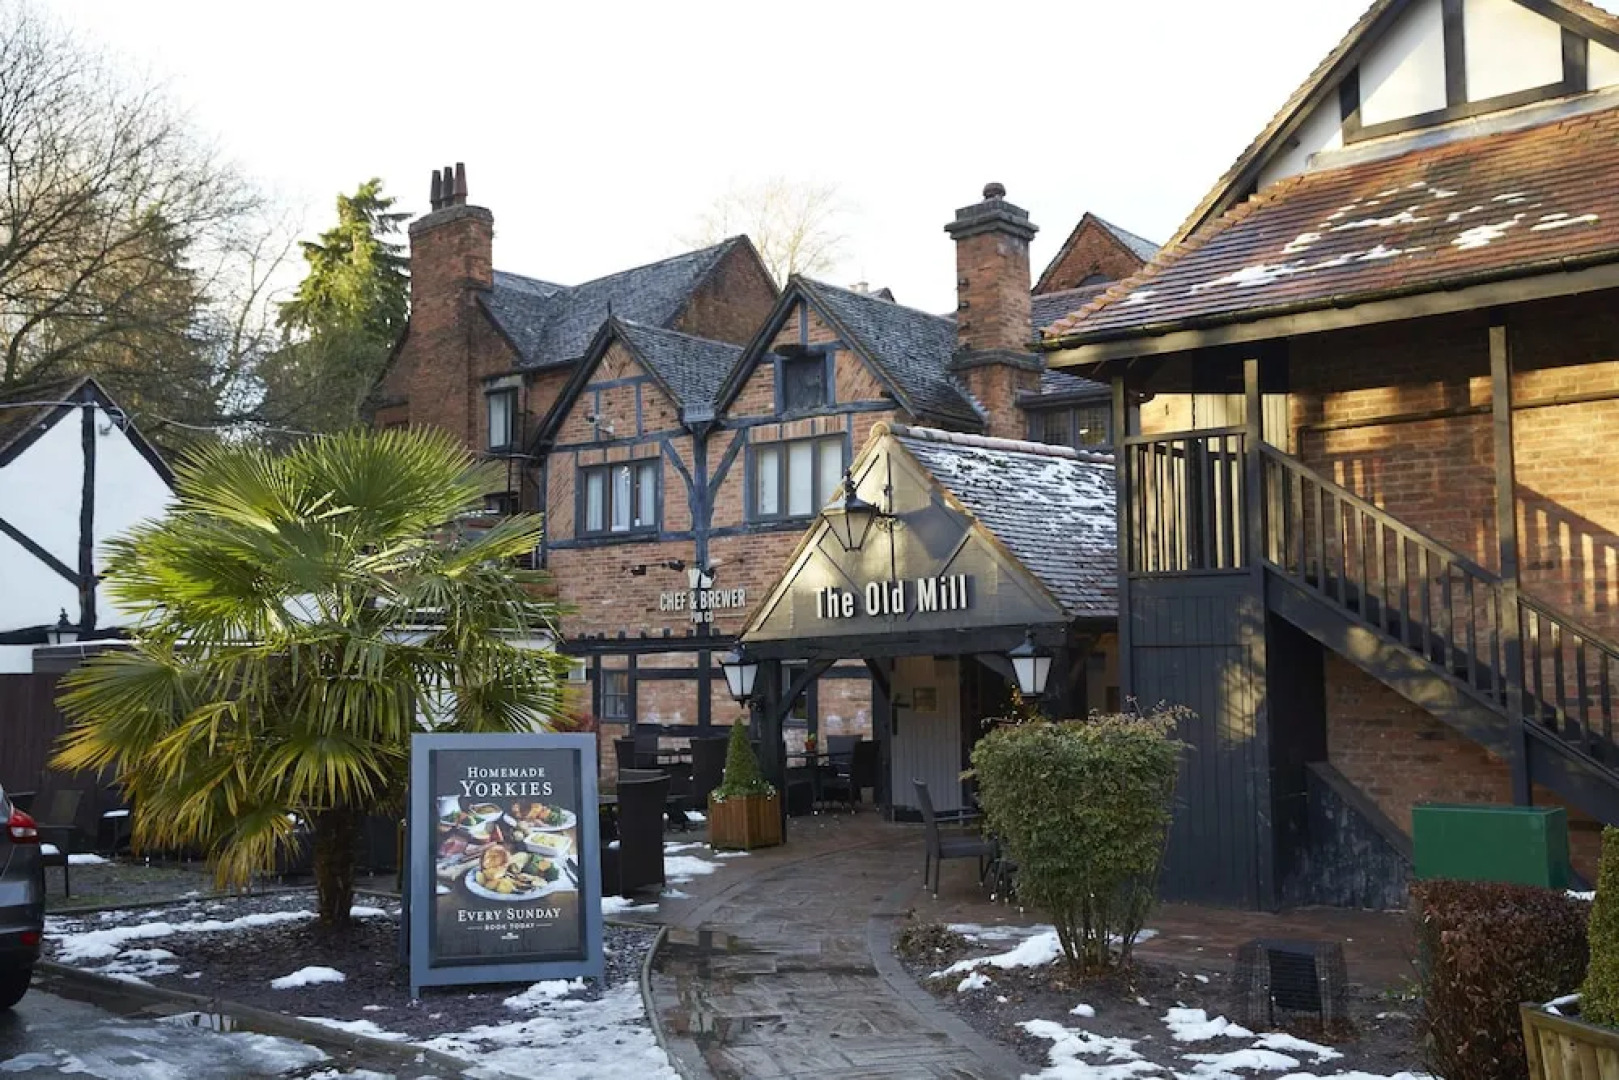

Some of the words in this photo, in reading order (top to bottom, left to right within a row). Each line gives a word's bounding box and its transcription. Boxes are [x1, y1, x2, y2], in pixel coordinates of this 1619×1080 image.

[660, 592, 686, 611] CHEF
[690, 591, 697, 609] &
[700, 588, 746, 609] BREWER
[815, 586, 854, 618] The
[865, 580, 905, 615] Old
[917, 574, 967, 612] Mill
[467, 766, 545, 778] HOMEMADE
[459, 780, 553, 797] YORKIES
[457, 909, 502, 922] EVERY
[506, 908, 561, 920] SUNDAY
